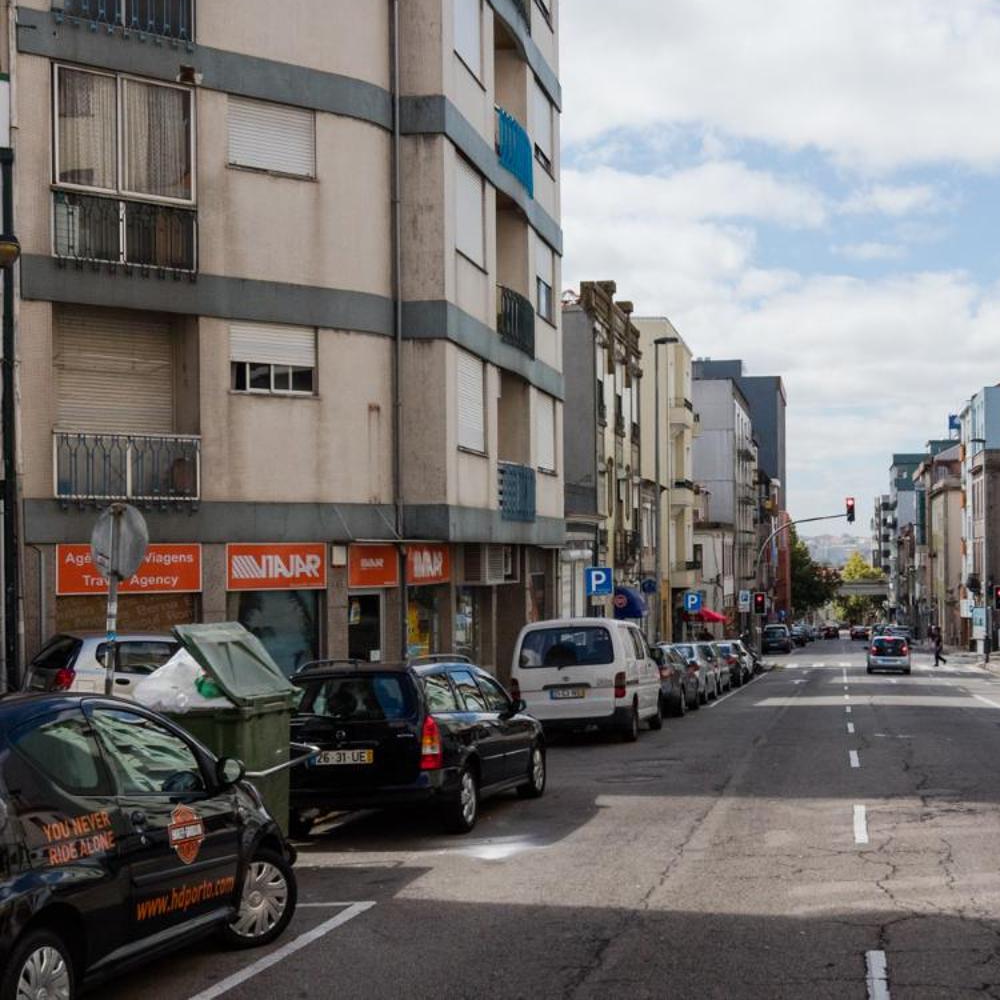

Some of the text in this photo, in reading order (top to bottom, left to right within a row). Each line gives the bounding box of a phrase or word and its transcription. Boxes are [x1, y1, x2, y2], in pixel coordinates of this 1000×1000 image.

[144, 552, 193, 566] Viagens
[130, 574, 178, 587] Agency
[591, 570, 606, 592] P
[688, 594, 698, 609] P
[42, 810, 112, 843] YOU NEVER
[50, 830, 117, 866] RIDE ALONE
[137, 876, 235, 921] www.hdporto.com
